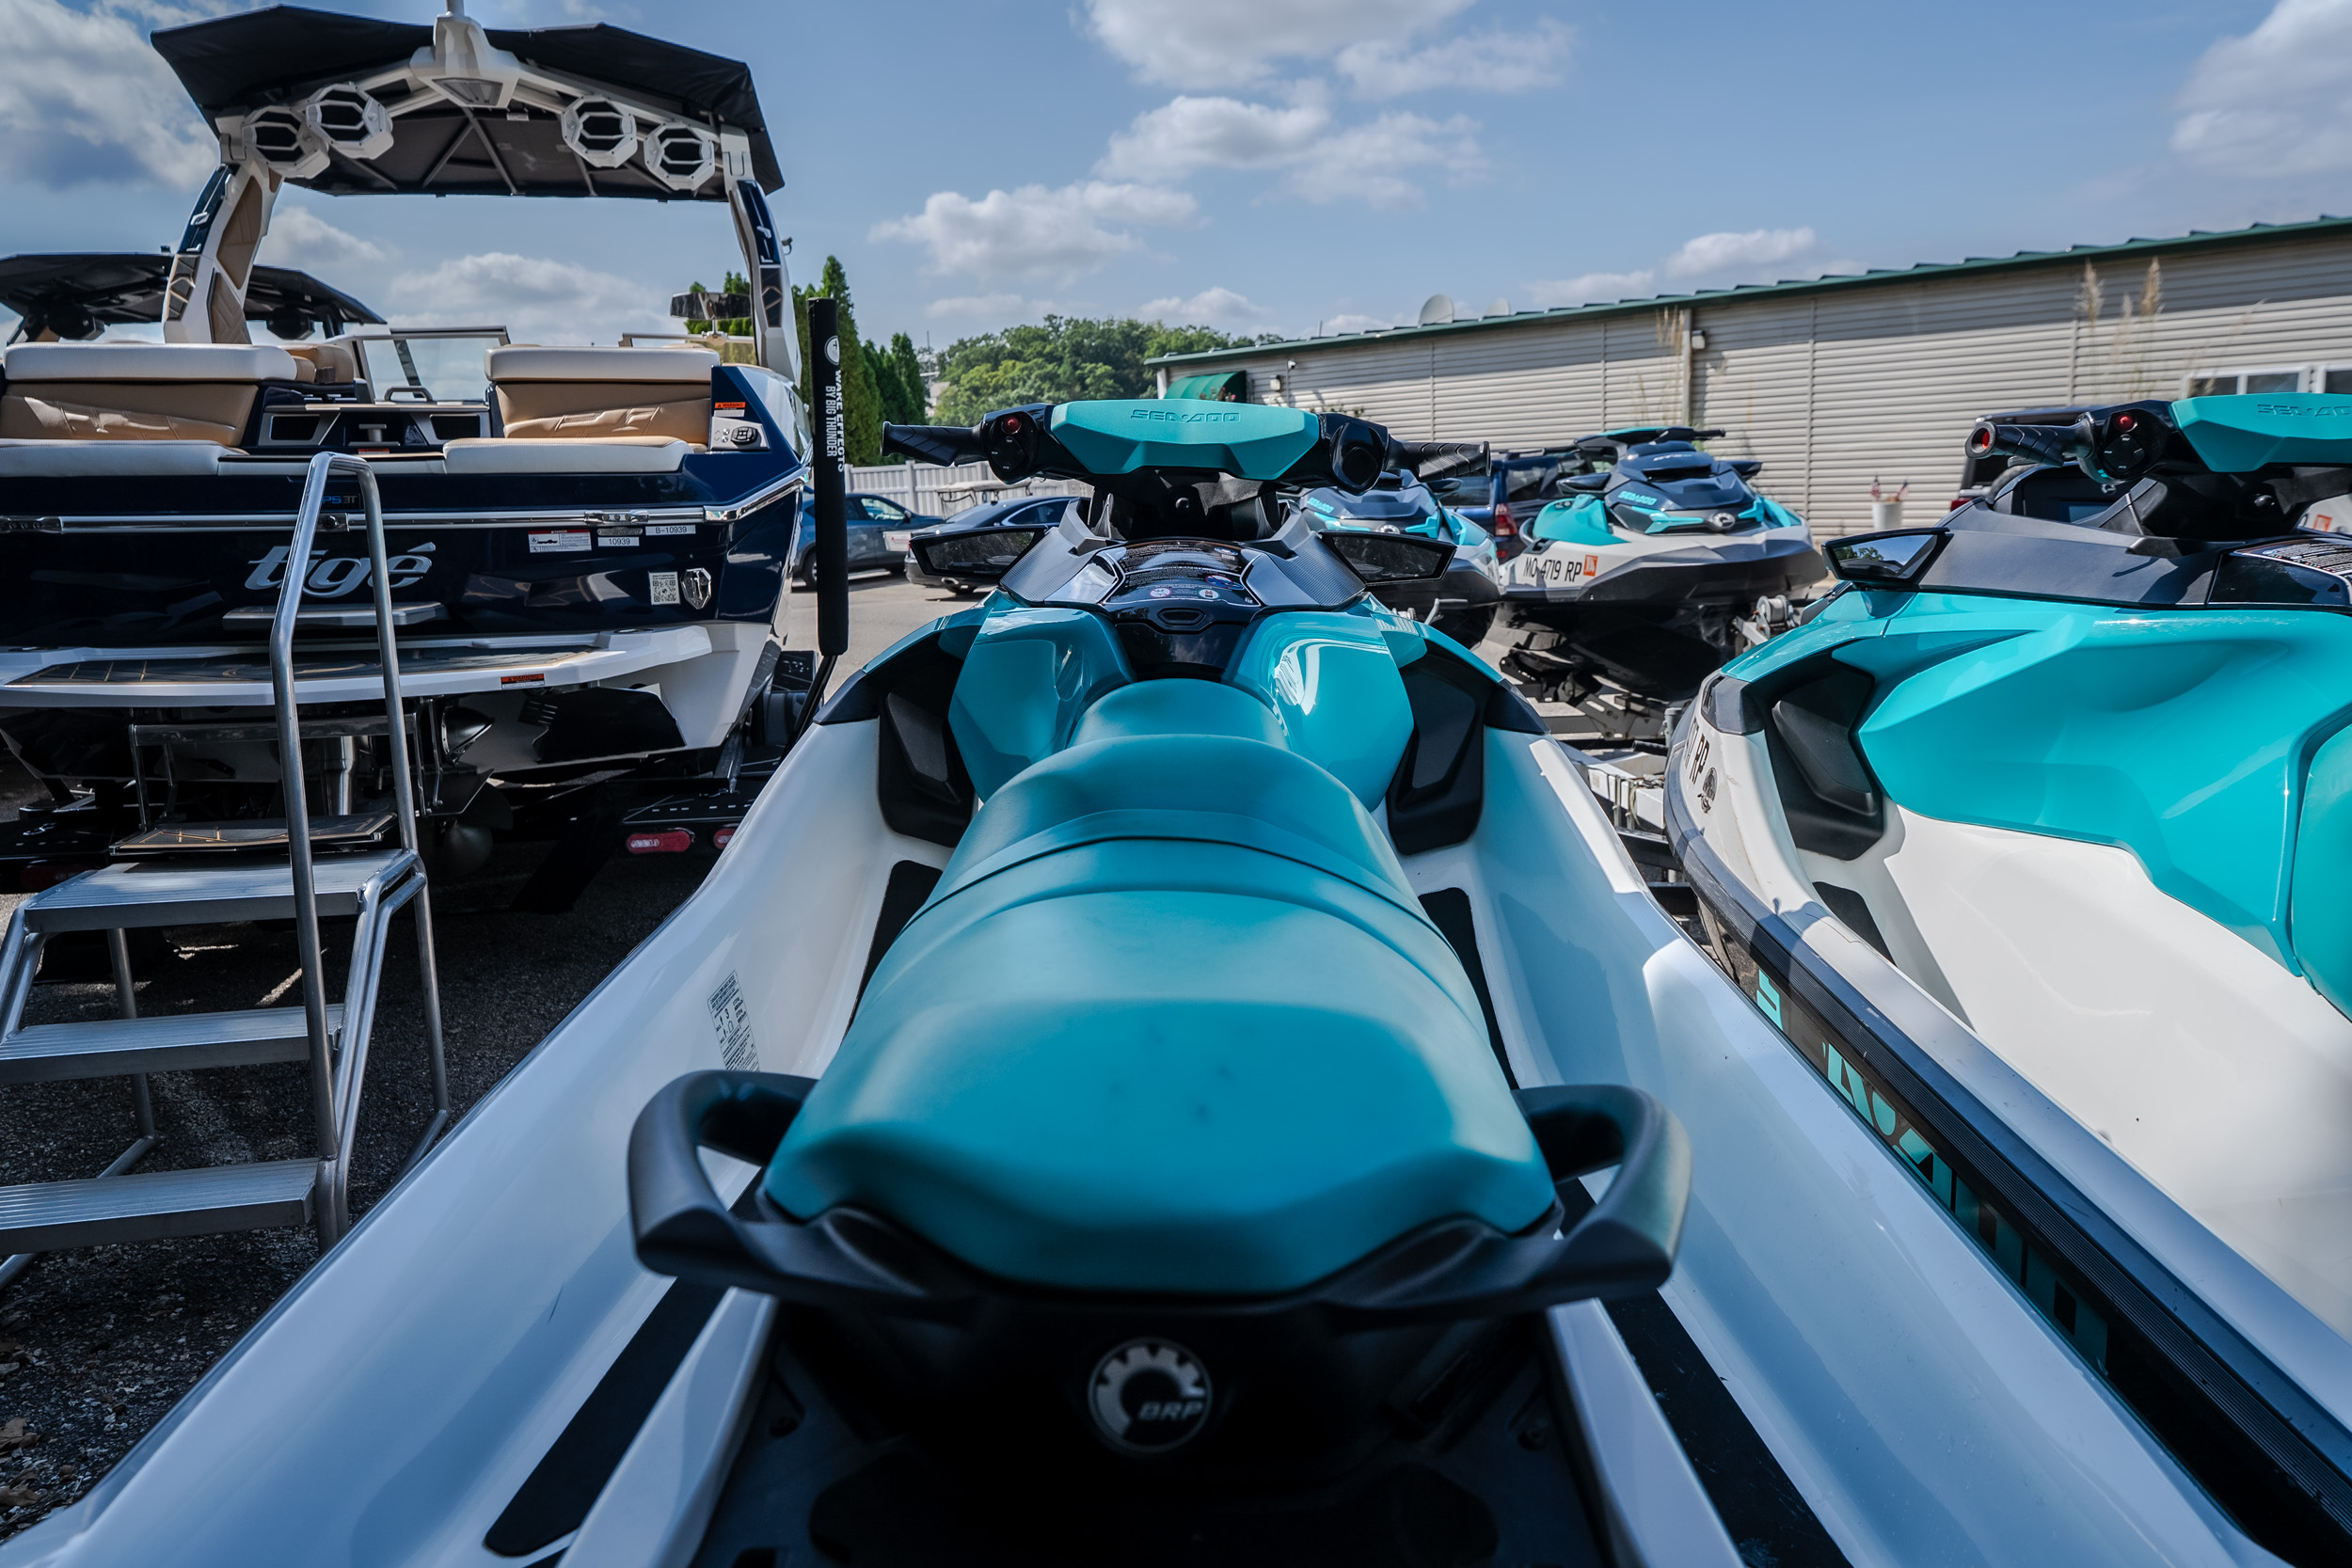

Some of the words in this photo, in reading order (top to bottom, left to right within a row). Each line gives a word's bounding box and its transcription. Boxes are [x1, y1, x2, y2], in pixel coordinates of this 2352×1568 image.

[825, 386, 836, 397] BY
[834, 370, 843, 411] WAKE
[825, 400, 836, 414] BIG
[825, 417, 837, 457] THUNDER
[655, 526, 688, 534] B-10939
[1523, 557, 1538, 578] MO
[1541, 559, 1562, 580] 4719
[1565, 561, 1582, 582] RP
[1690, 733, 1710, 785] RP
